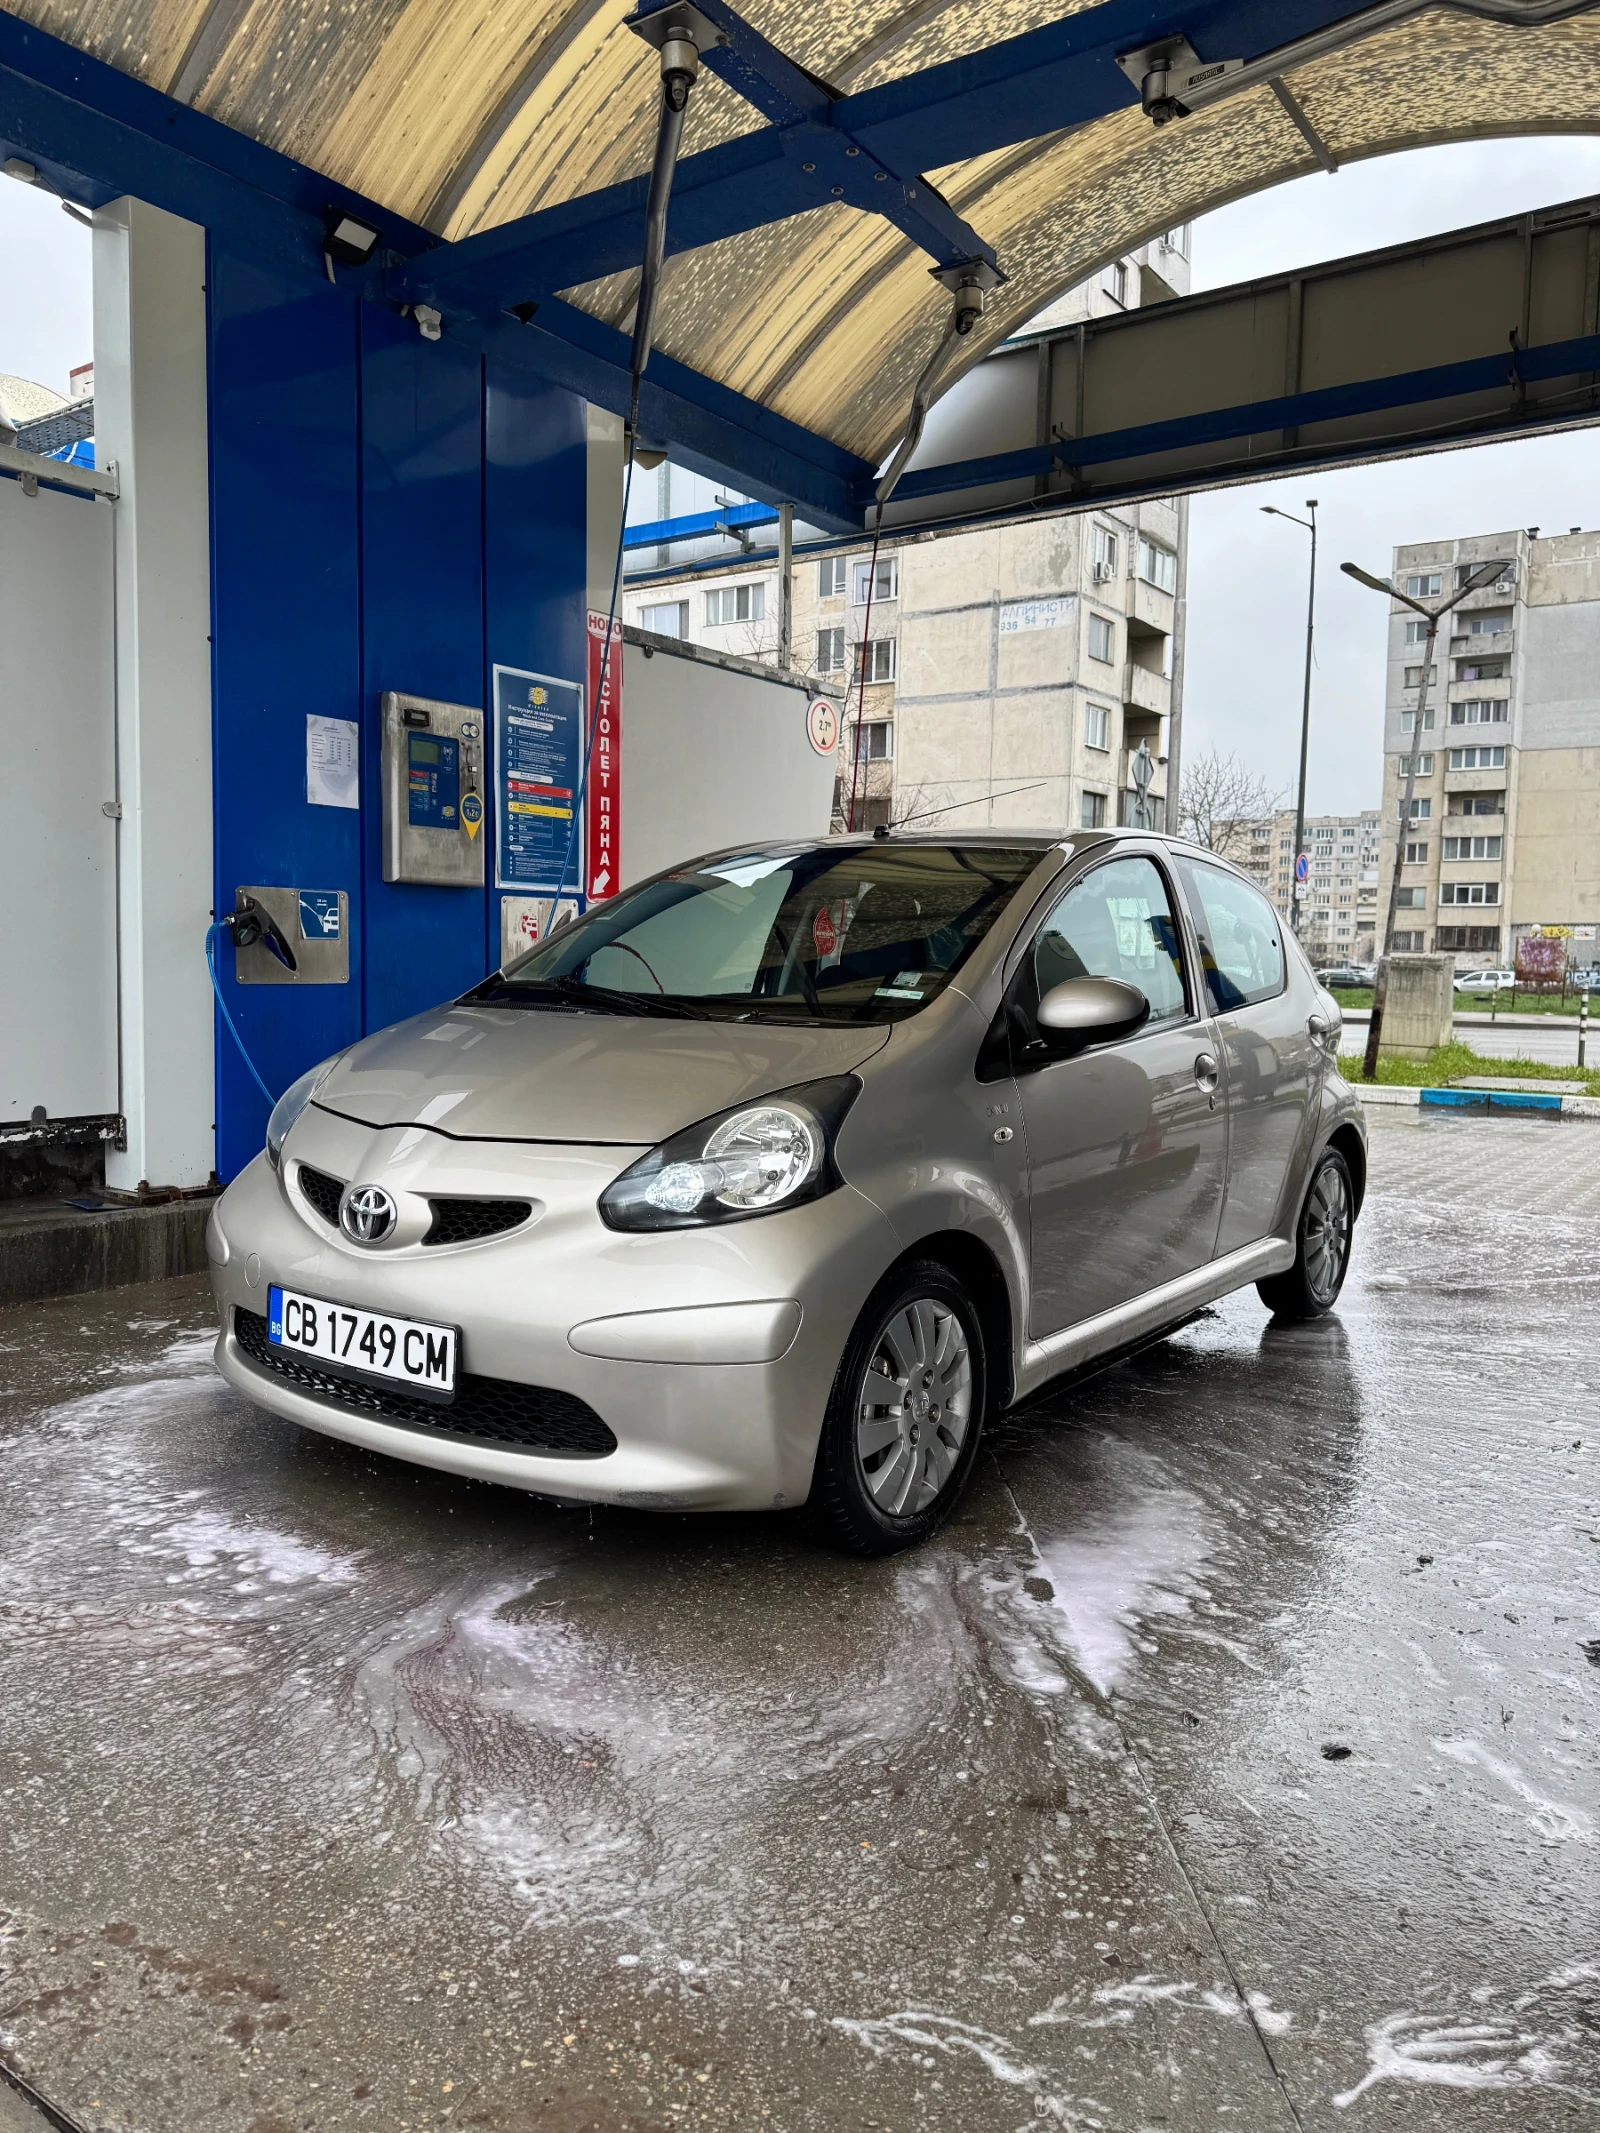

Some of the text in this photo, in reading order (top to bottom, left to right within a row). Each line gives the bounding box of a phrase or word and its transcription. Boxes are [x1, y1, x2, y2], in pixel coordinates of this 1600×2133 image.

[600, 796, 611, 867] ПЯНА
[271, 1321, 281, 1335] BG
[286, 1299, 448, 1382] CB 1749 CM
